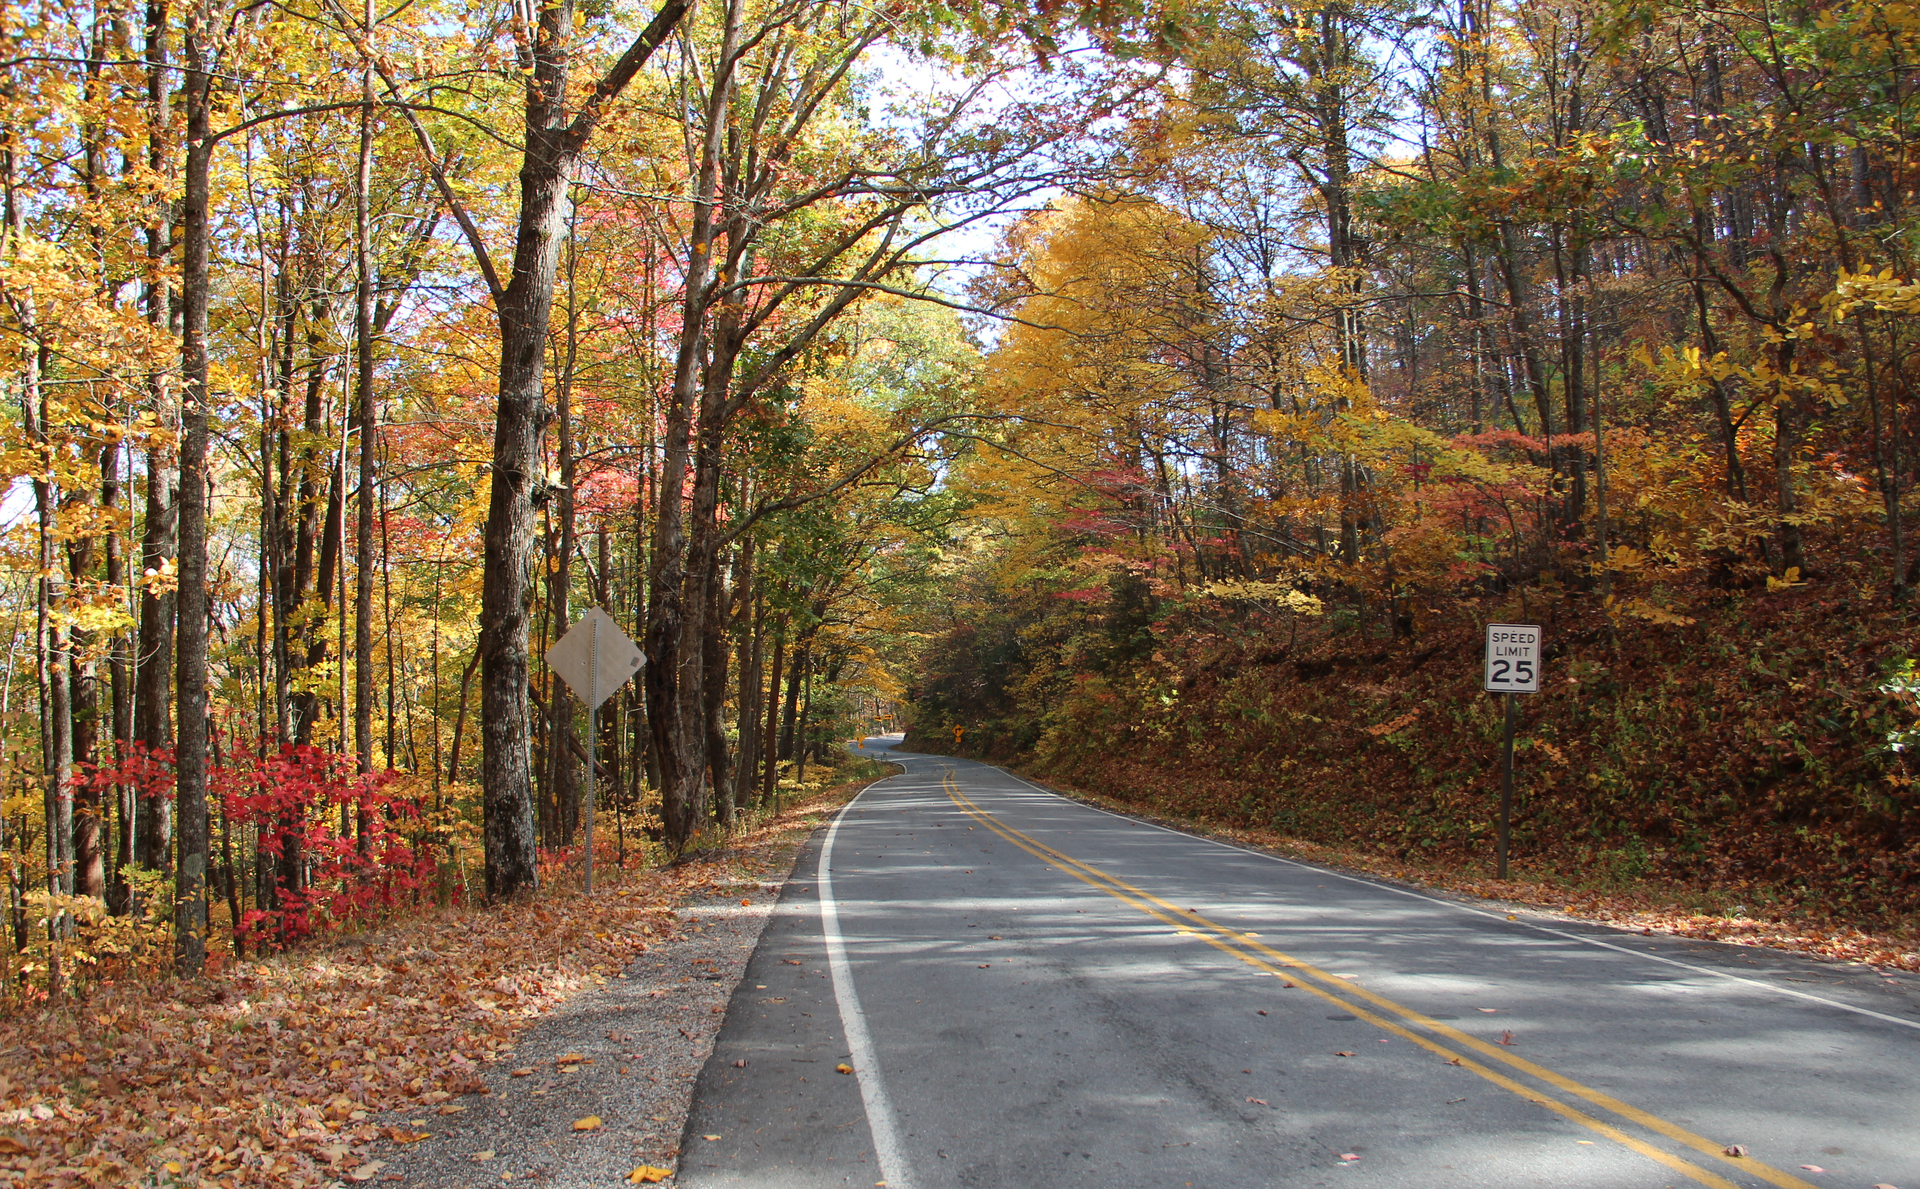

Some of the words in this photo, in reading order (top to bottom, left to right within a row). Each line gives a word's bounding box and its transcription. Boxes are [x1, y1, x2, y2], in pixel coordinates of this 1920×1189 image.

[1492, 632, 1535, 643] SPEED
[1496, 646, 1530, 656] LIMIT
[1491, 659, 1533, 684] 25
